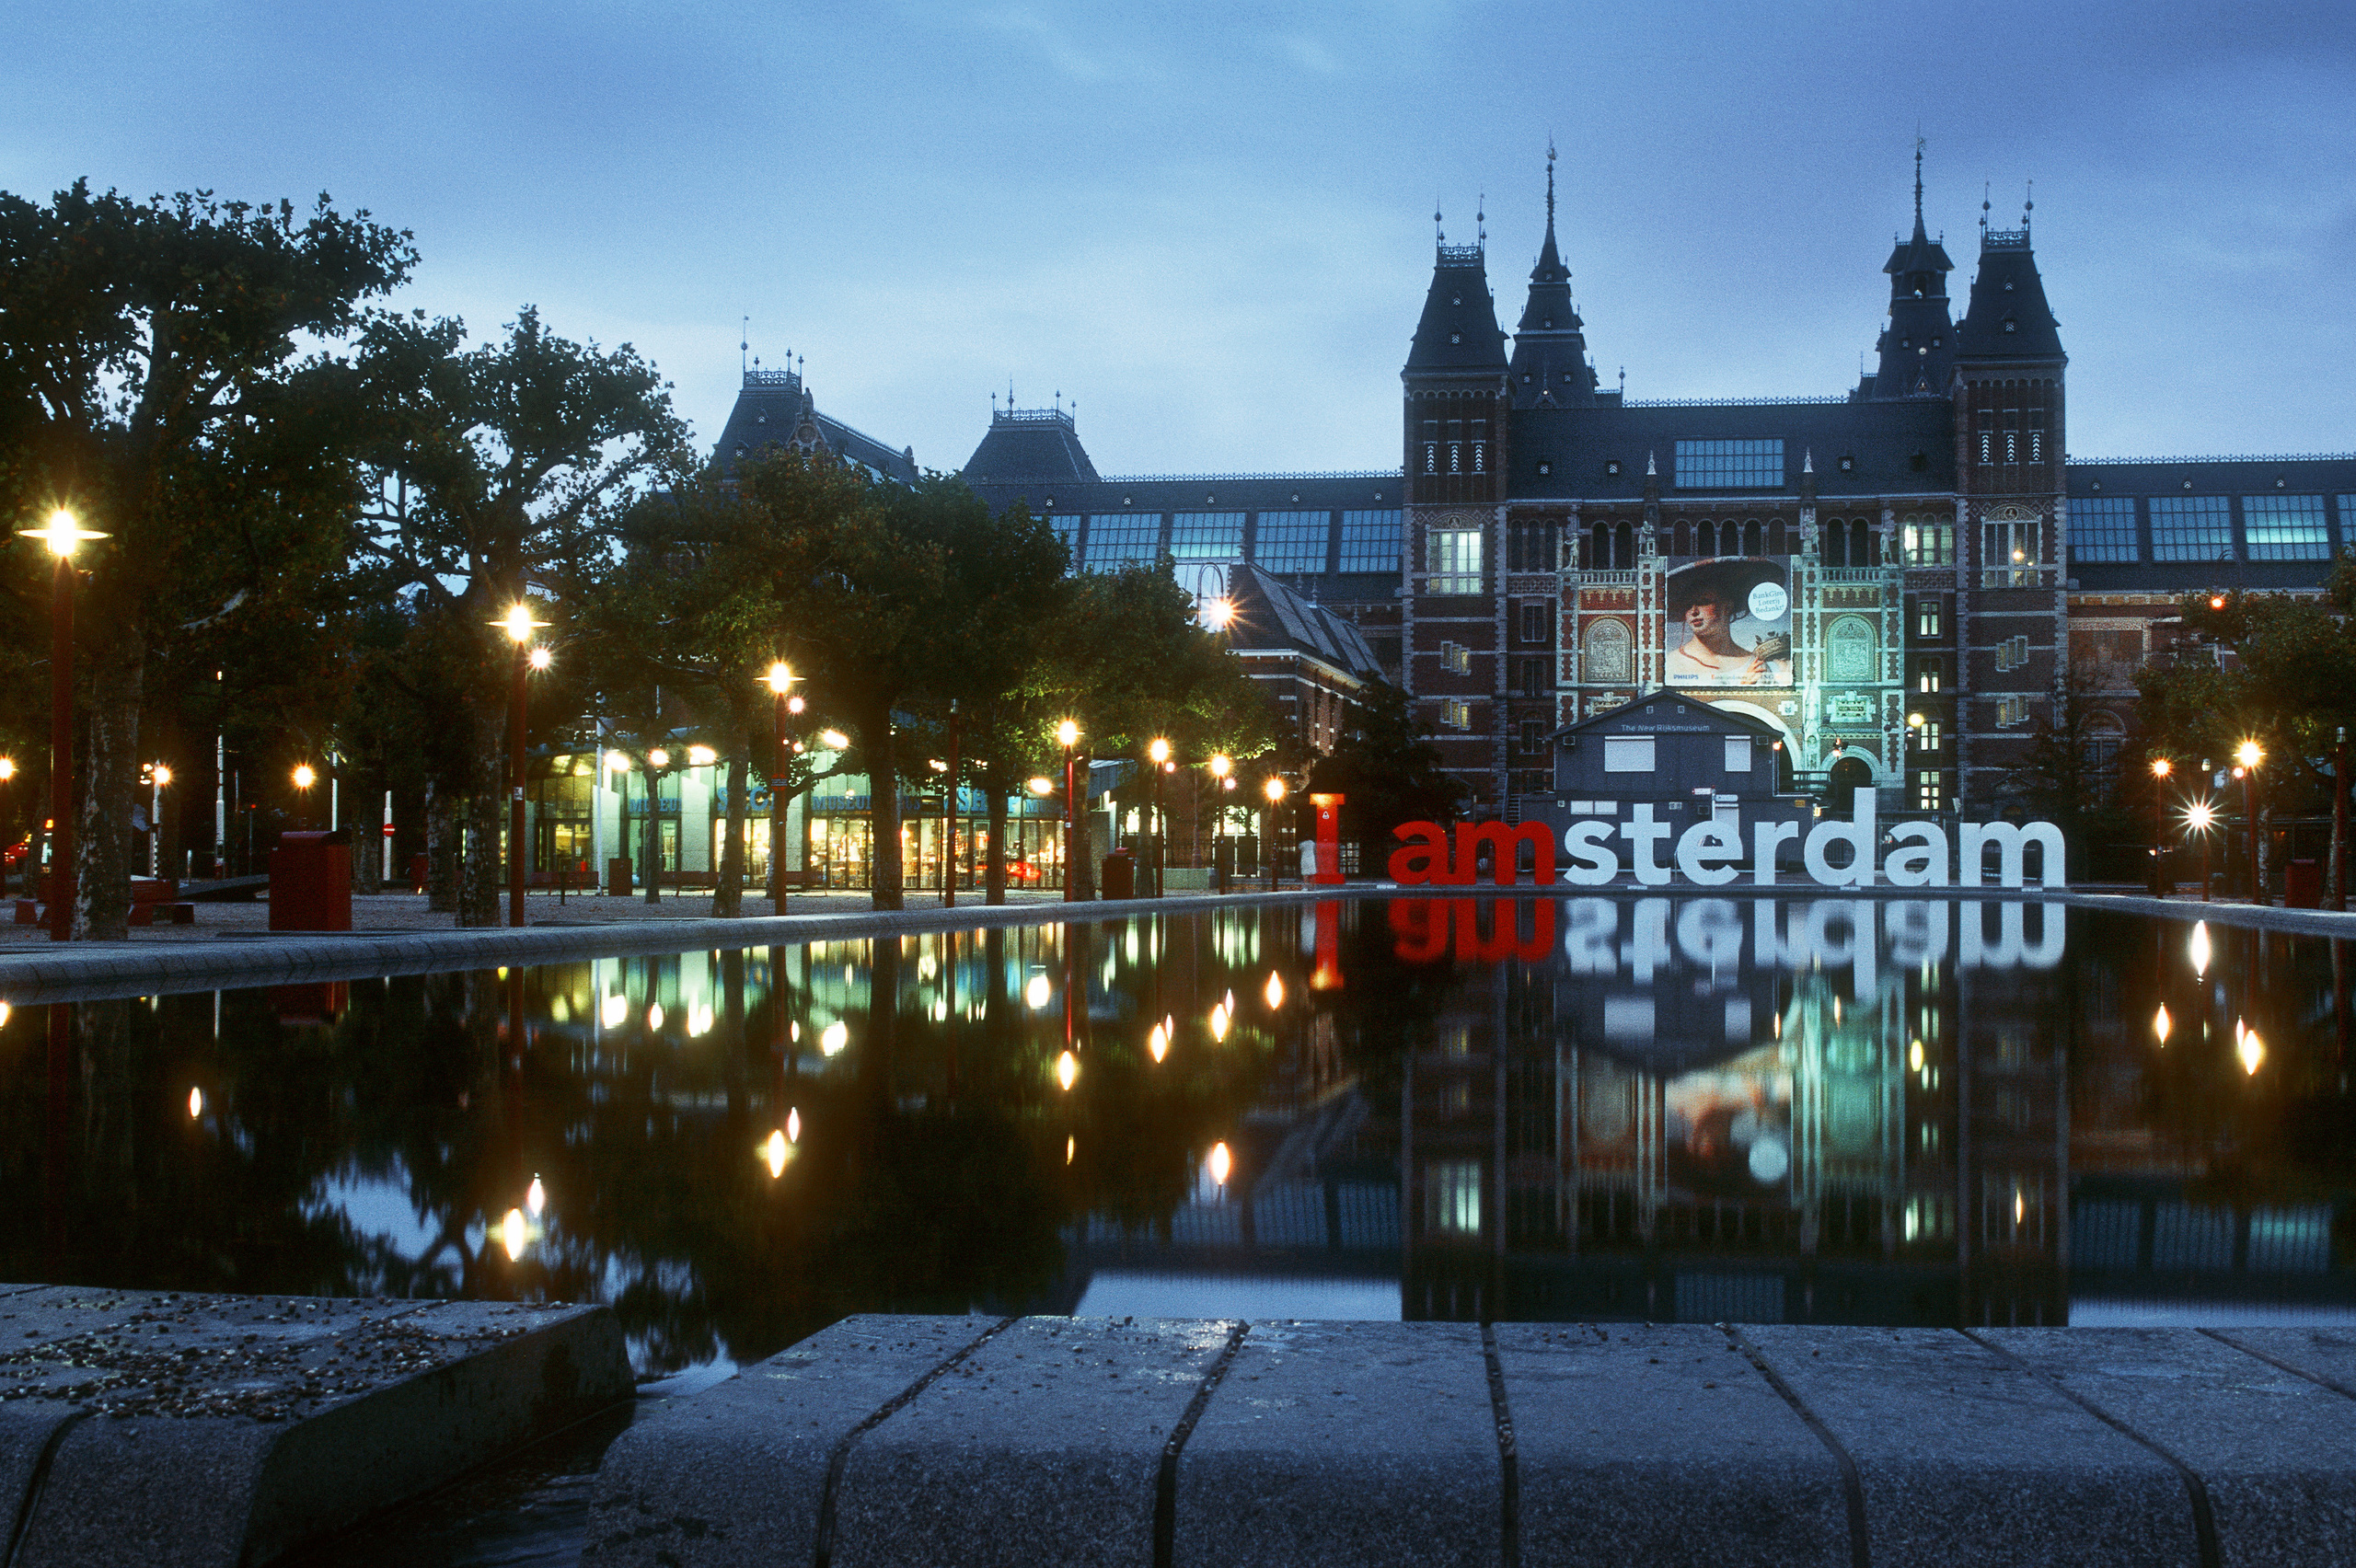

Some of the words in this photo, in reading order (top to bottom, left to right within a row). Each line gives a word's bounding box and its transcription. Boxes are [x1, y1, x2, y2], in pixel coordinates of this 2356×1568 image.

[1752, 590, 1784, 599] BankGiro
[1657, 724, 1710, 732] Rijksmuseum
[812, 796, 871, 811] MUSEU
[958, 786, 1022, 812] SHP
[1388, 787, 2065, 887] amsterdam
